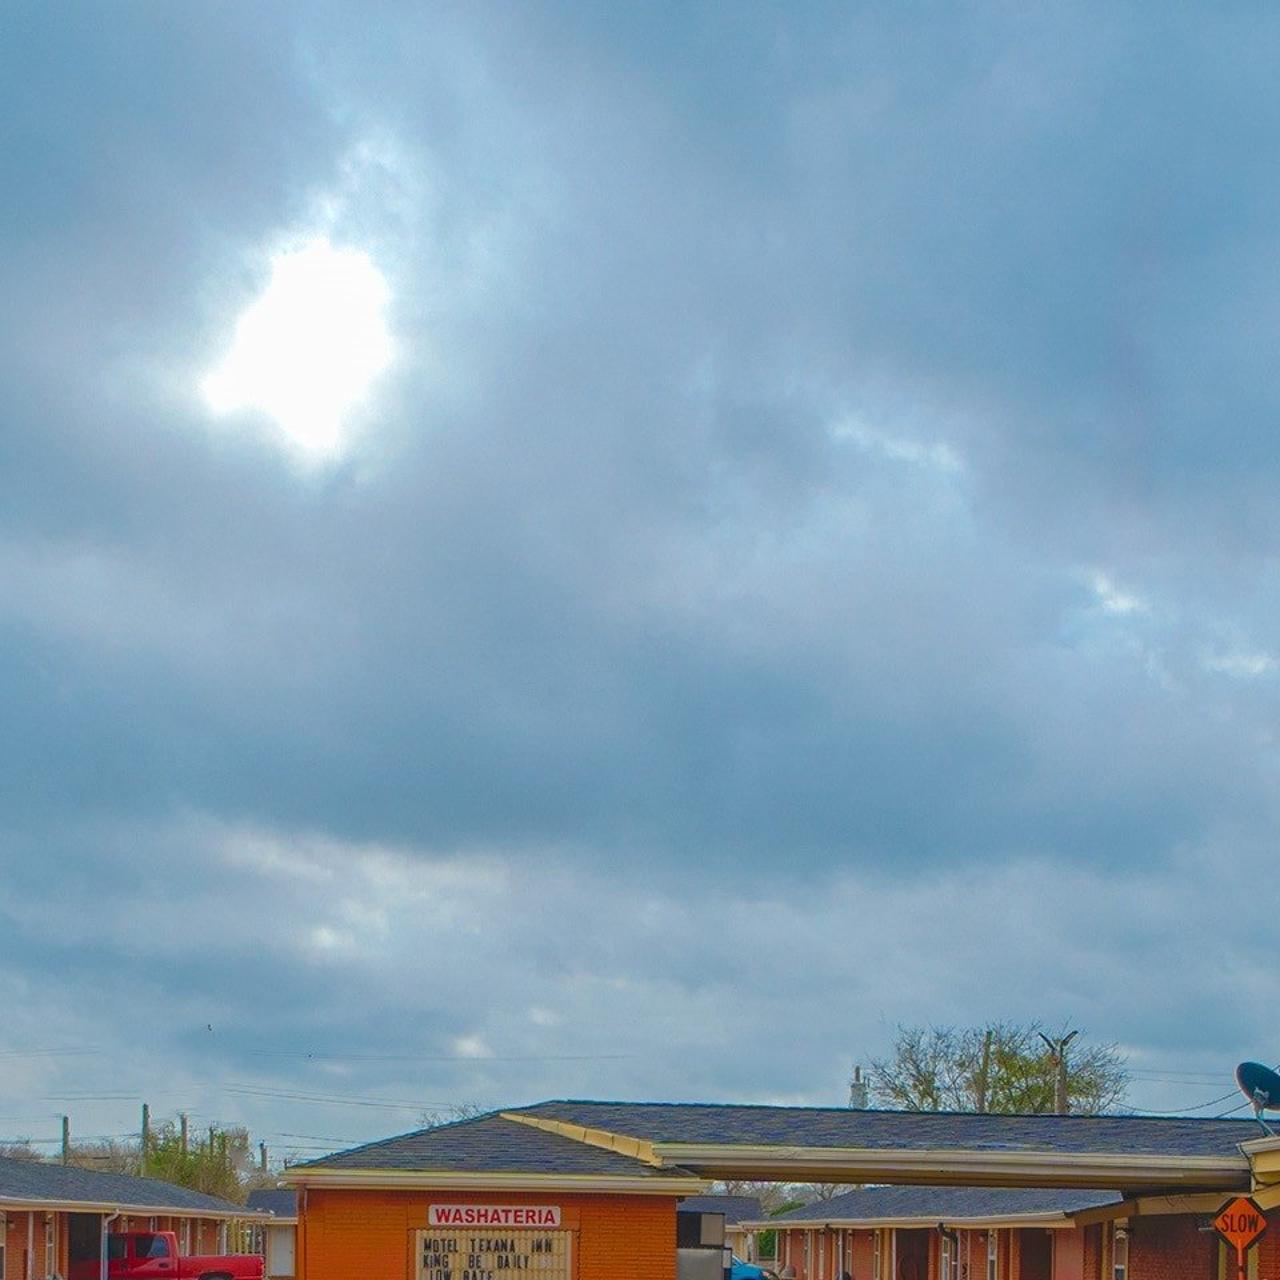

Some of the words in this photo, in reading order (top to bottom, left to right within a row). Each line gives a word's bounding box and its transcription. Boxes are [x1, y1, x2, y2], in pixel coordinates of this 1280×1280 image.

[435, 1208, 556, 1224] WASHATERIA
[1220, 1213, 1260, 1233] SLOW
[423, 1238, 459, 1253] MOTEL
[470, 1239, 516, 1253] TEXANA
[423, 1254, 449, 1269] KING
[496, 1255, 530, 1269] DAILY
